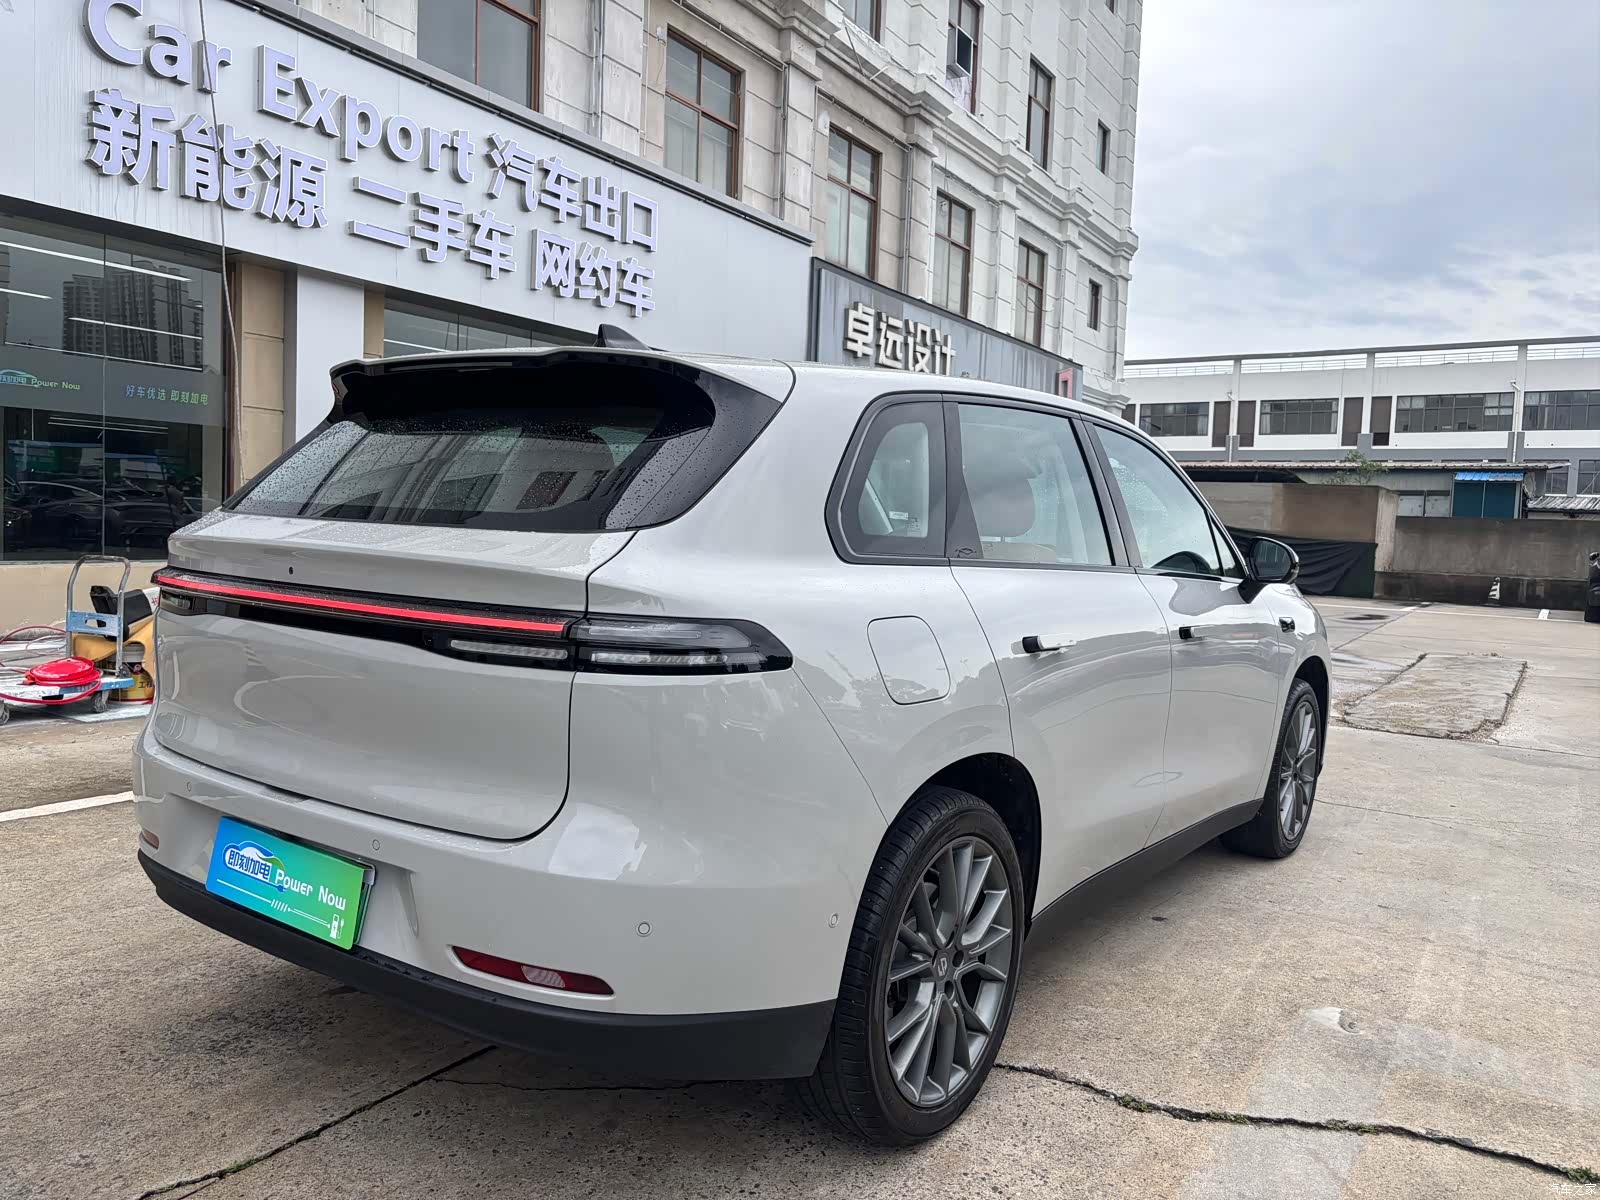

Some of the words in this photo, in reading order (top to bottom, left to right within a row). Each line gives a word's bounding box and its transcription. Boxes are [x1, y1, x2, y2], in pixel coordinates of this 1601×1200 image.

[83, 0, 233, 93] Car
[258, 45, 474, 183] Export
[485, 134, 660, 251] 汽车出口
[87, 88, 328, 229] 新能源
[349, 176, 517, 279] 二手车
[531, 228, 655, 317] 网约车
[844, 301, 957, 376] 卓远设计
[31, 378, 58, 388] Power
[62, 381, 81, 390] Now
[125, 384, 166, 401] 好车优选
[170, 389, 209, 406] 即刻加电
[227, 849, 272, 881] 即刻加电
[275, 868, 314, 897] Power
[318, 885, 347, 911] Now
